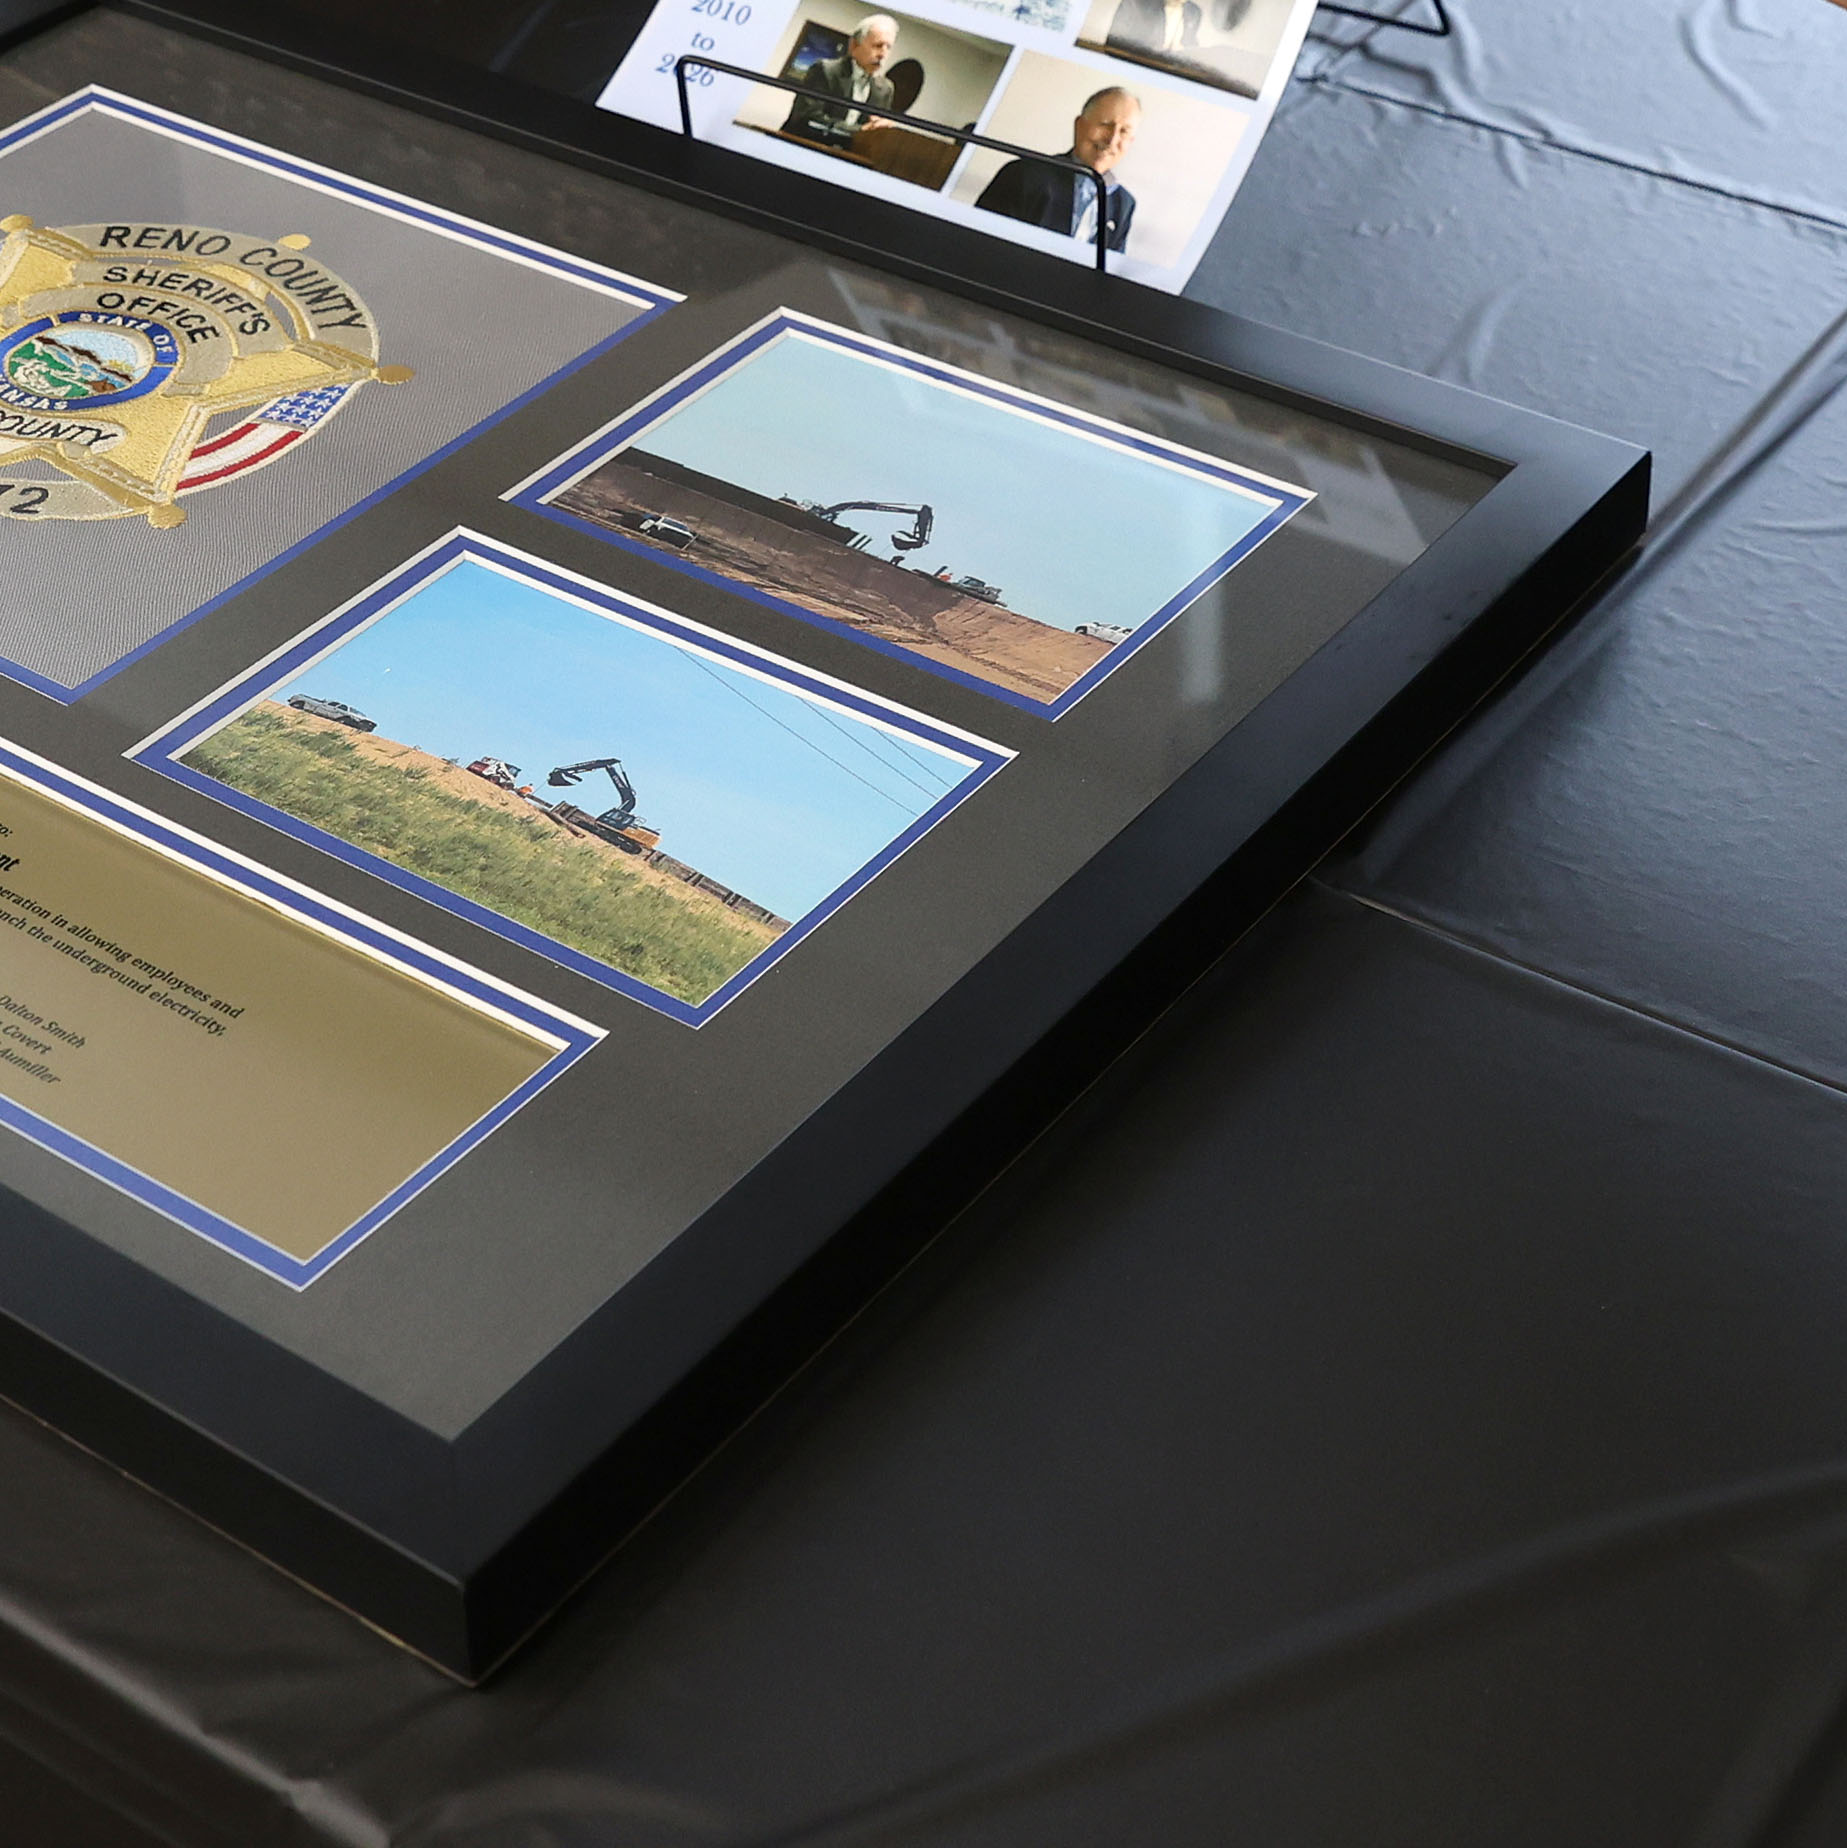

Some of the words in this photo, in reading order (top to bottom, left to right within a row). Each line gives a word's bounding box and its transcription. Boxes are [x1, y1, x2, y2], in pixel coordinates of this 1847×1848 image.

[690, 32, 715, 52] to
[655, 53, 716, 88] 226
[99, 225, 232, 256] RENO
[239, 246, 367, 330] COUNTY
[103, 265, 271, 336] SHERIFF'S
[78, 311, 152, 332] STATE
[153, 333, 174, 358] OF
[96, 292, 220, 344] OFFICE
[25, 925, 53, 943] the
[51, 939, 153, 994] underground
[147, 990, 227, 1037] electricity,
[49, 913, 68, 928] in
[66, 924, 133, 963] allowing
[130, 957, 212, 1002] employees
[208, 998, 245, 1019] and
[1, 1024, 52, 1055] Covert
[39, 1020, 86, 1049] Smith
